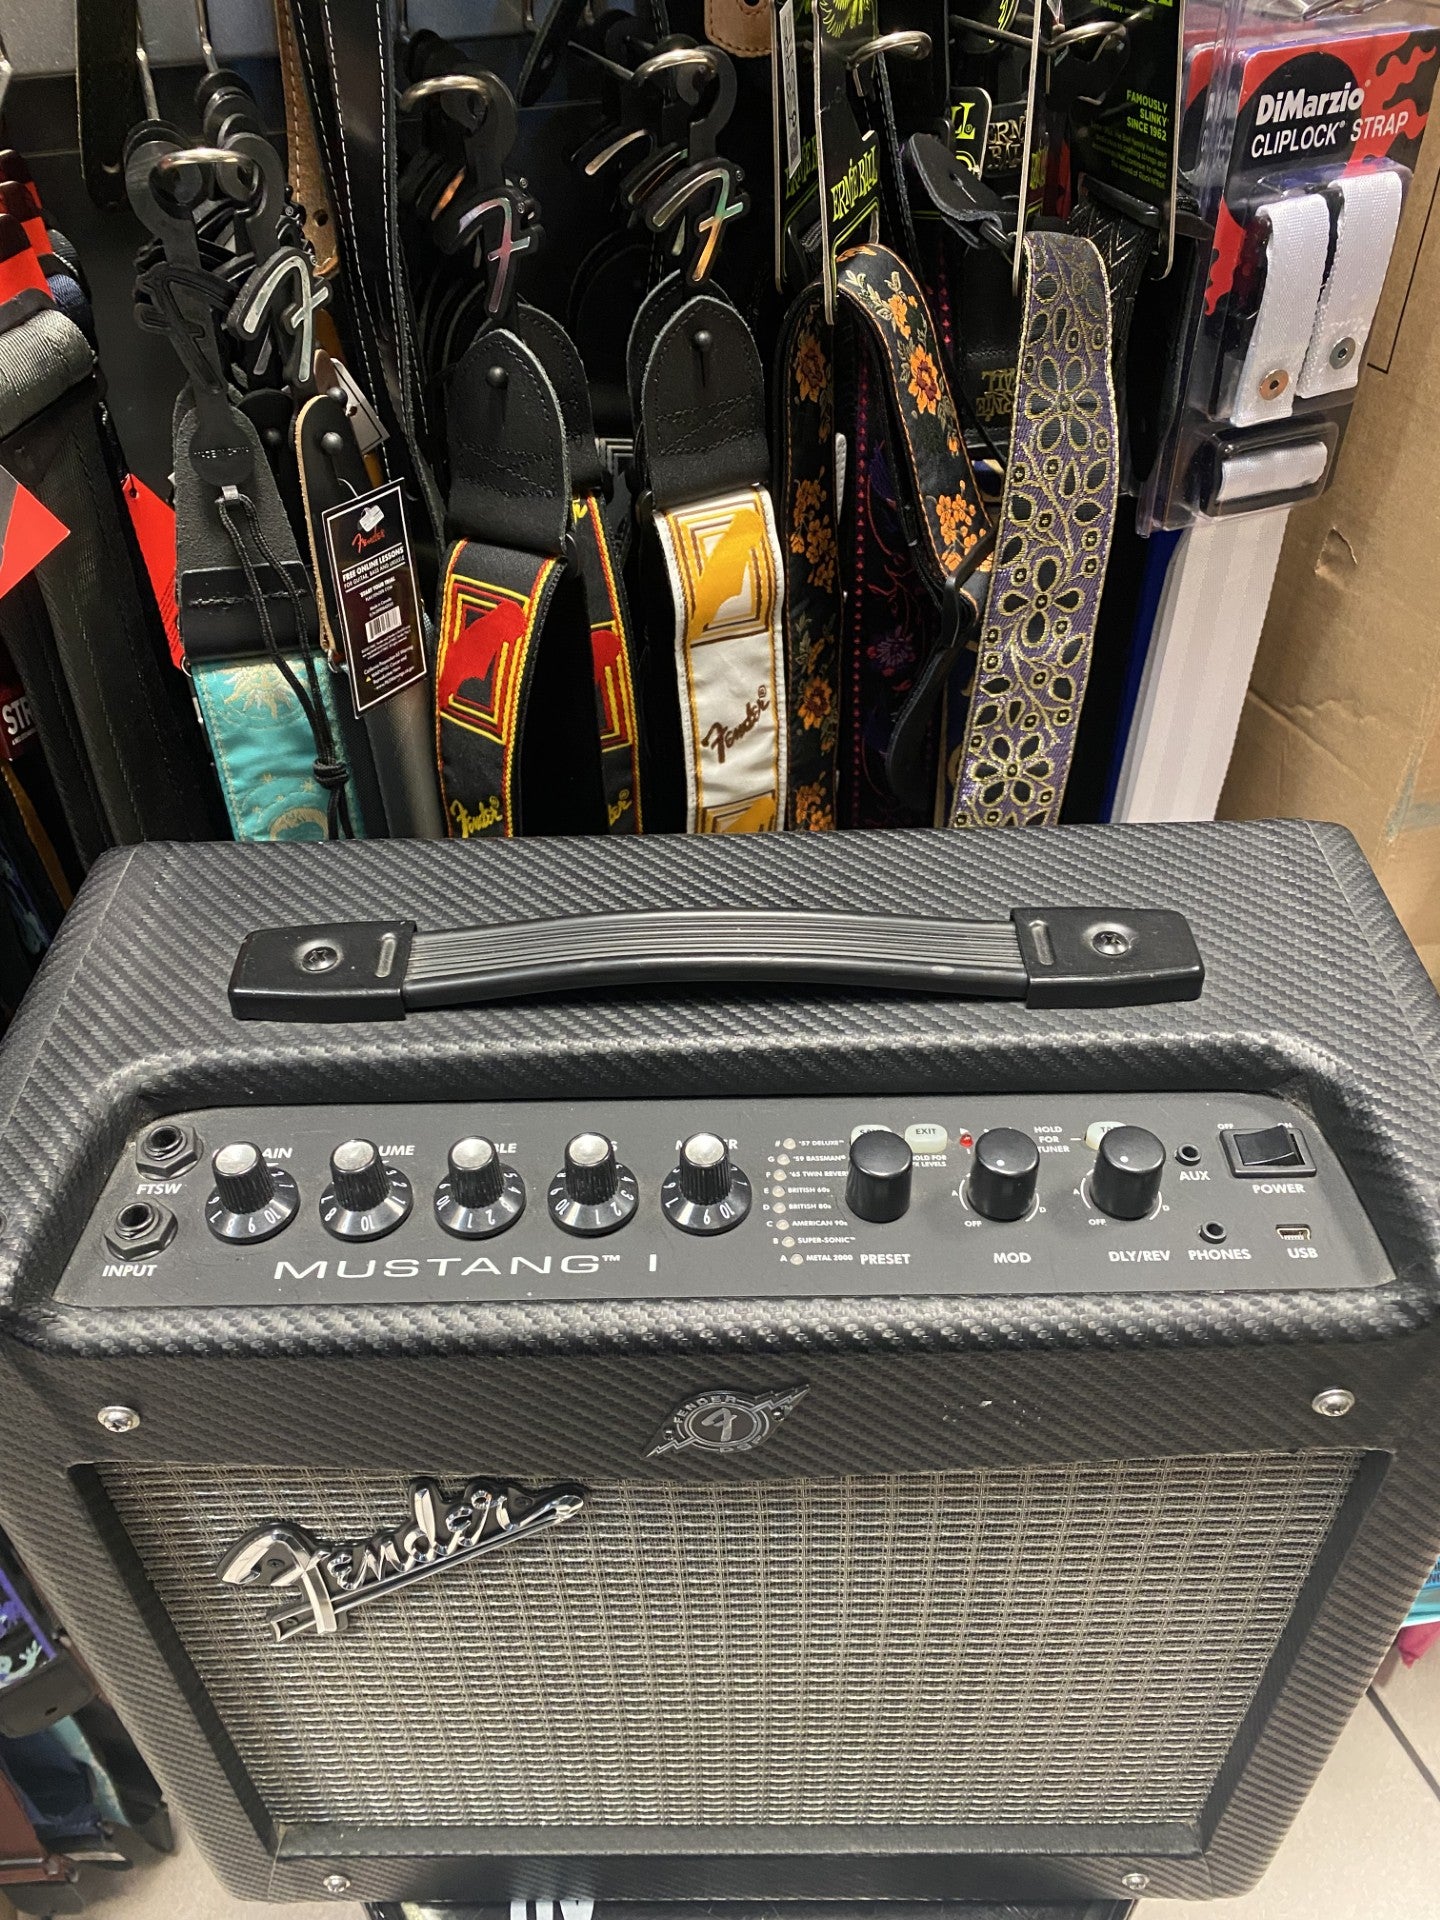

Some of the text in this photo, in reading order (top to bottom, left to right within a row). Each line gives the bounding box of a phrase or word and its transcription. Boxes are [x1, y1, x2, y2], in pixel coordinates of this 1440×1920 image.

[1126, 89, 1168, 114] FAMOUSLY
[1139, 108, 1168, 127] SLINKY
[1126, 116, 1149, 134] SINCE
[1150, 124, 1167, 142] 1962
[1350, 111, 1409, 142] STRAP
[857, 145, 879, 197] BALL
[342, 545, 404, 582] FREE ONLINE LESSONS
[1038, 1135, 1060, 1143] FOR
[1037, 1145, 1070, 1153] TUNER
[767, 1155, 775, 1163] G
[802, 1170, 823, 1178] TWIN
[824, 1170, 849, 1178] REVER
[1179, 1171, 1211, 1182] AUX
[136, 1183, 182, 1195] FTSW
[763, 1187, 770, 1195] E
[1252, 1184, 1306, 1195] POWER
[436, 1195, 451, 1211] 10
[484, 1208, 496, 1226] 2
[555, 1198, 570, 1216] 10
[609, 1201, 622, 1217] 2
[718, 1202, 736, 1219] 10
[762, 1203, 770, 1211] D
[263, 1207, 282, 1224] 10
[324, 1207, 338, 1222] 8
[360, 1214, 376, 1232] 10
[1088, 1218, 1107, 1226] OFF
[766, 1220, 774, 1228] C
[964, 1220, 982, 1228] OFF
[772, 1237, 779, 1245] B
[780, 1253, 854, 1262] A METAL 2000
[860, 1253, 911, 1266] PRESET
[993, 1252, 1032, 1265] MOD
[1108, 1250, 1171, 1263] DLY/REV
[1187, 1248, 1319, 1261] PHONES USB
[649, 1254, 657, 1272] I
[102, 1264, 157, 1277] INPUT
[673, 1394, 738, 1424] FENDER
[221, 1487, 585, 1642] Fender
